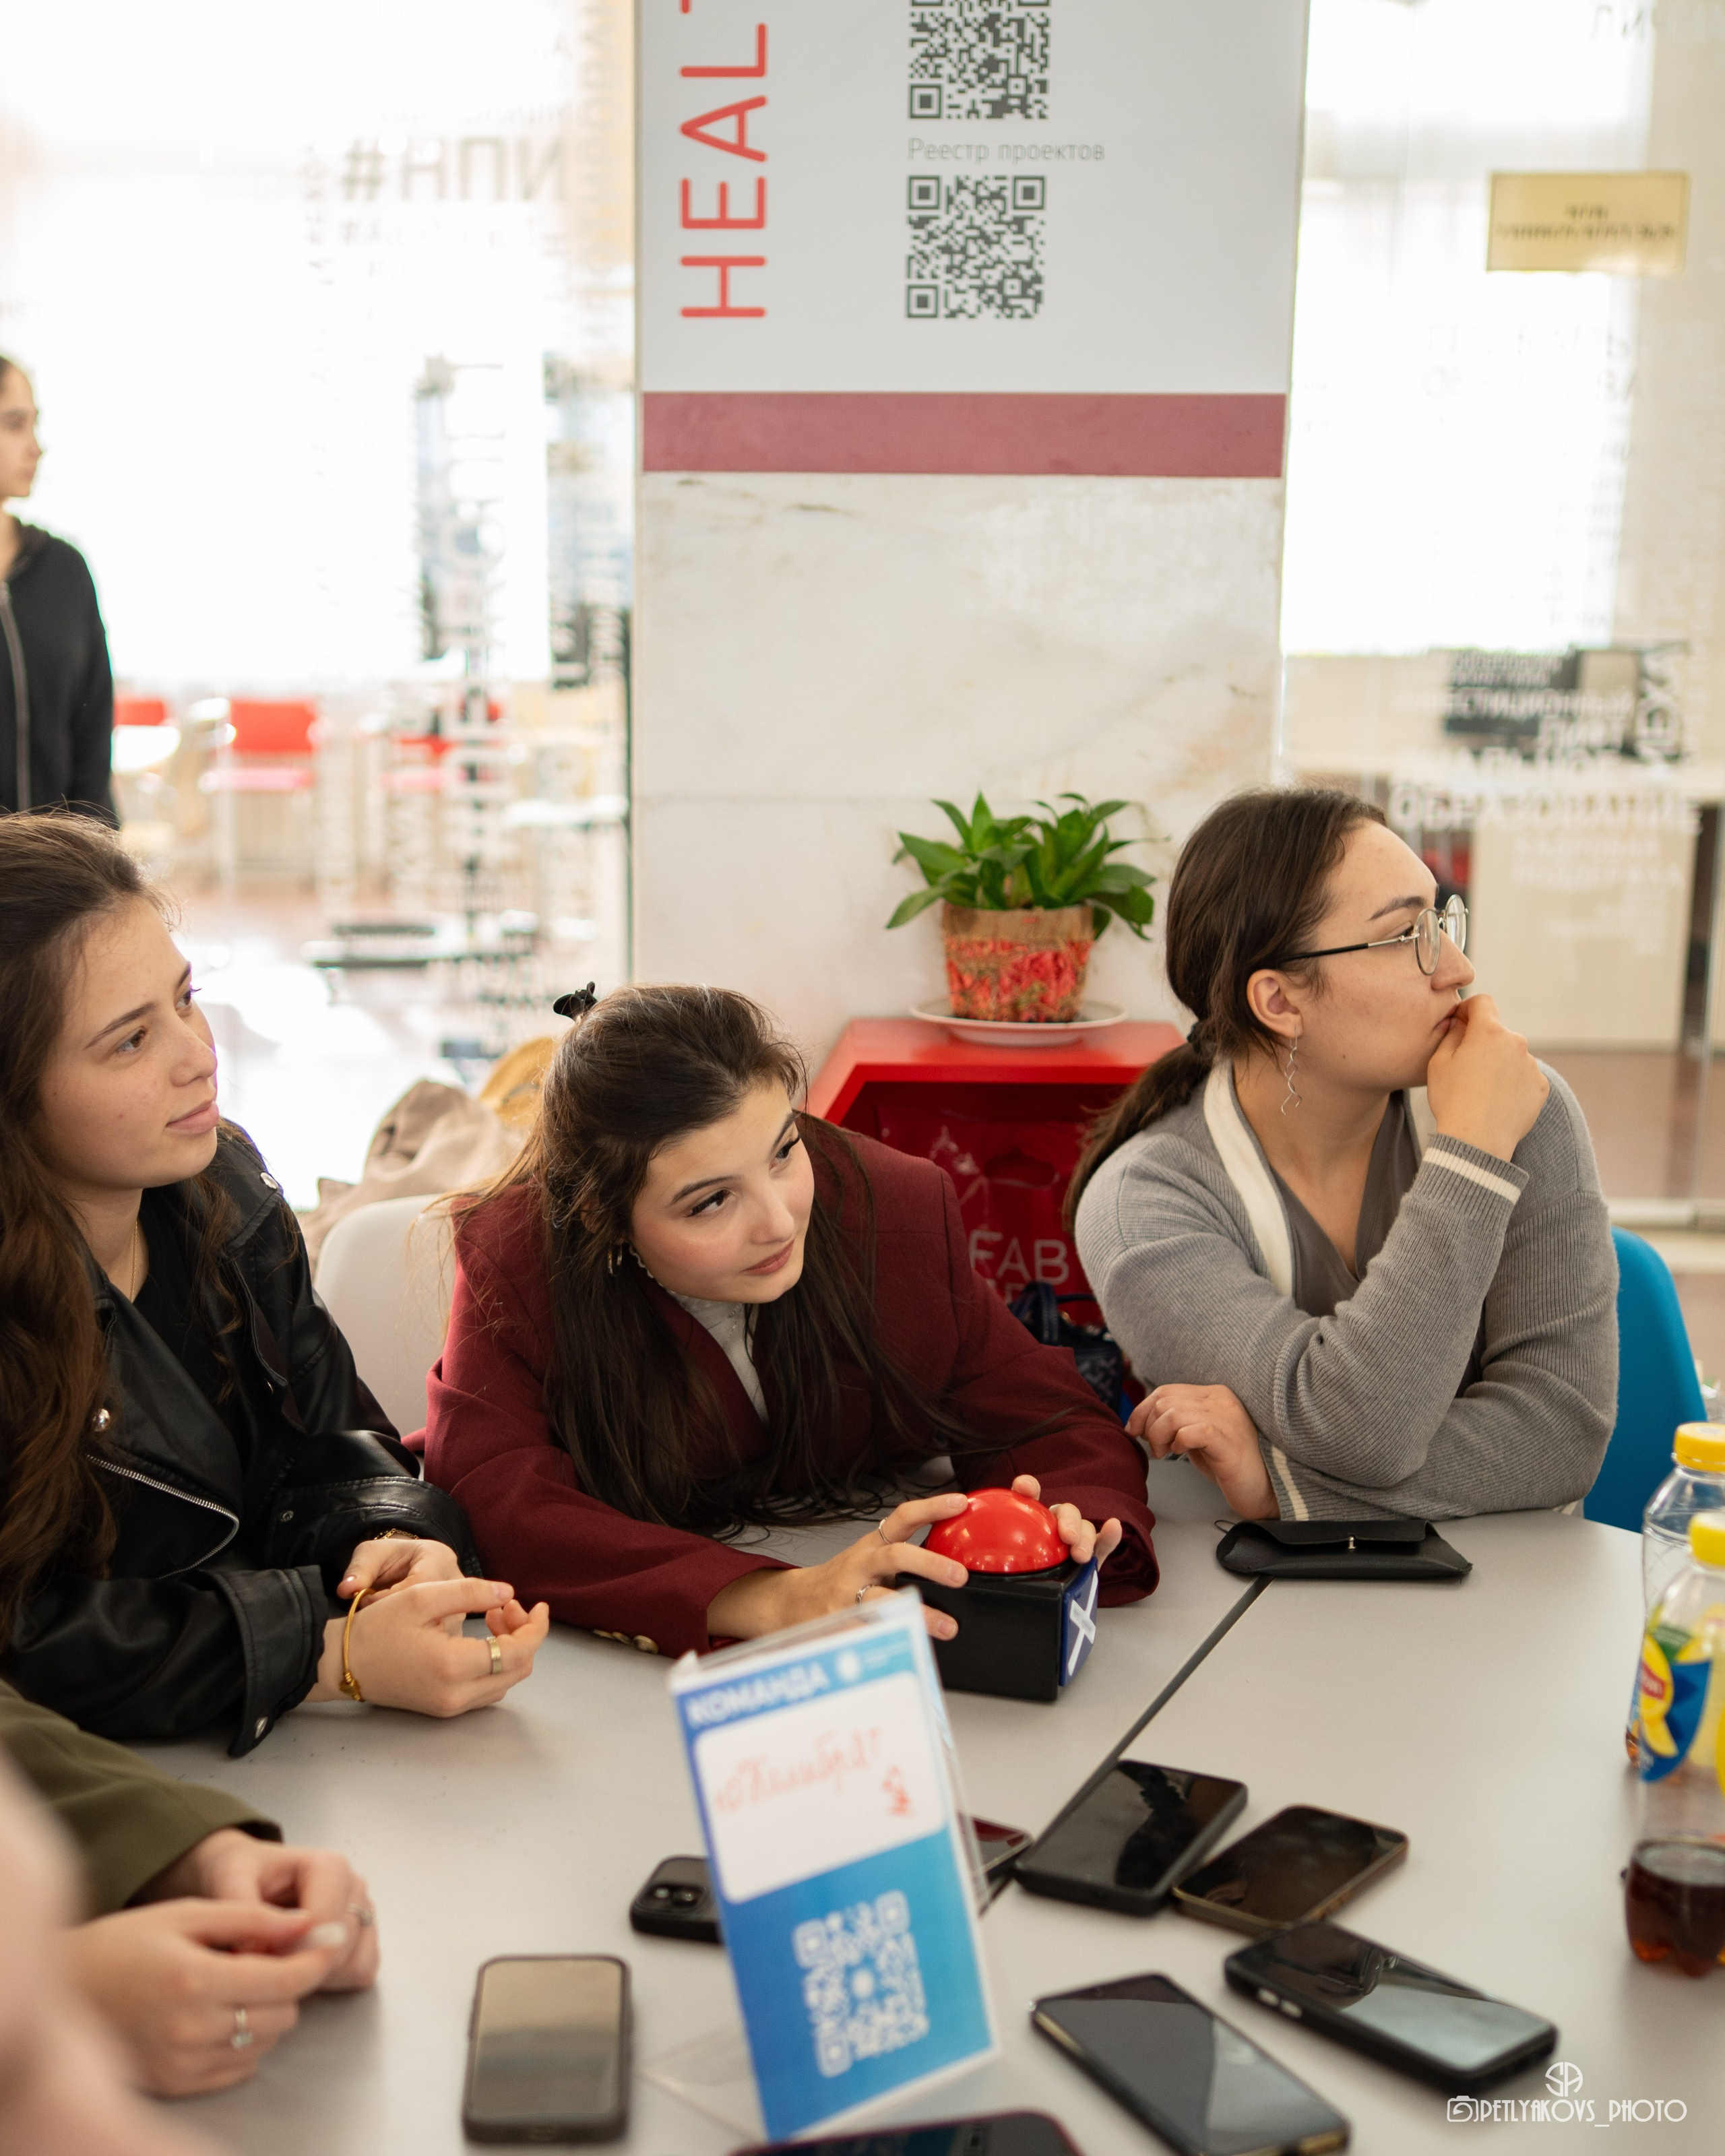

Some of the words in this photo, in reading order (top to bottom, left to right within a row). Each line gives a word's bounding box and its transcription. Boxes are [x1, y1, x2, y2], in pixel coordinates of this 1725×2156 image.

[680, 0, 766, 317] HEAL
[908, 137, 989, 163] Реестр
[999, 142, 1105, 163] проектов
[969, 1229, 1069, 1286] FAB
[687, 1661, 830, 1730] КОМАНДА
